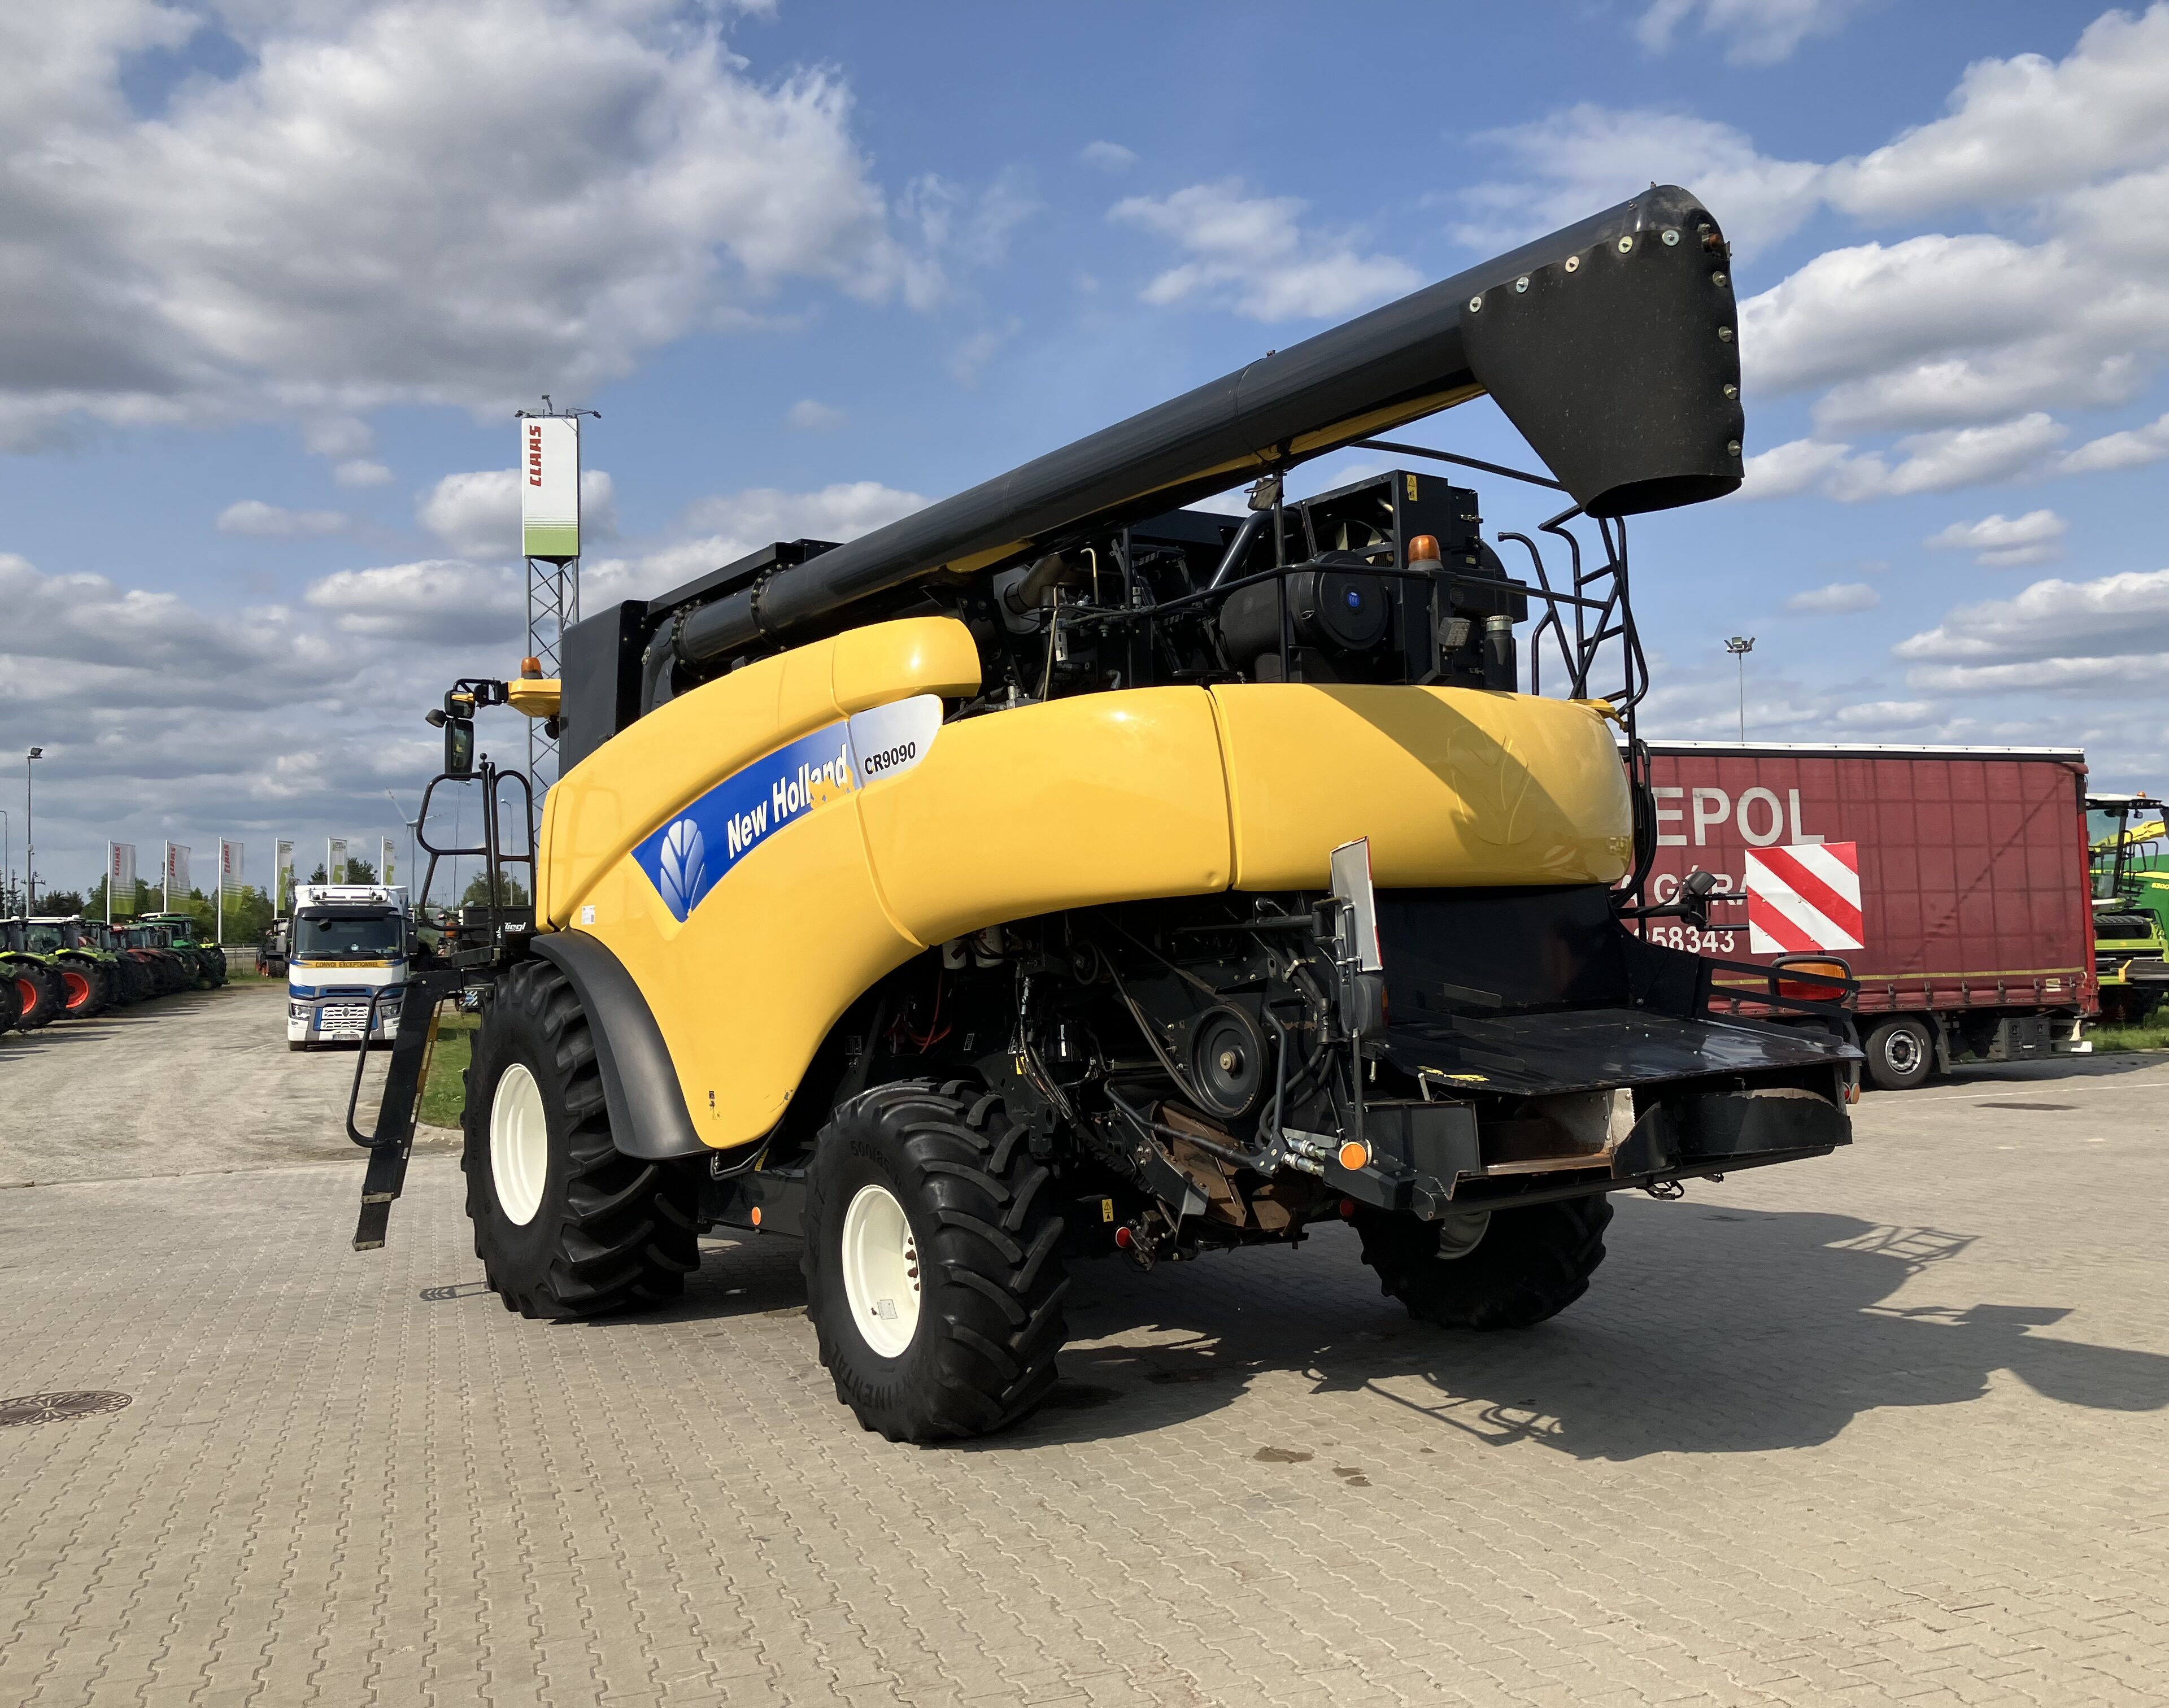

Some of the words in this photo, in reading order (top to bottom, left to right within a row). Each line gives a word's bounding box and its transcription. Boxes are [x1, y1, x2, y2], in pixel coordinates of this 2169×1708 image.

[529, 425, 542, 487] CLAAS
[864, 741, 916, 775] CR9090
[727, 800, 768, 859] New
